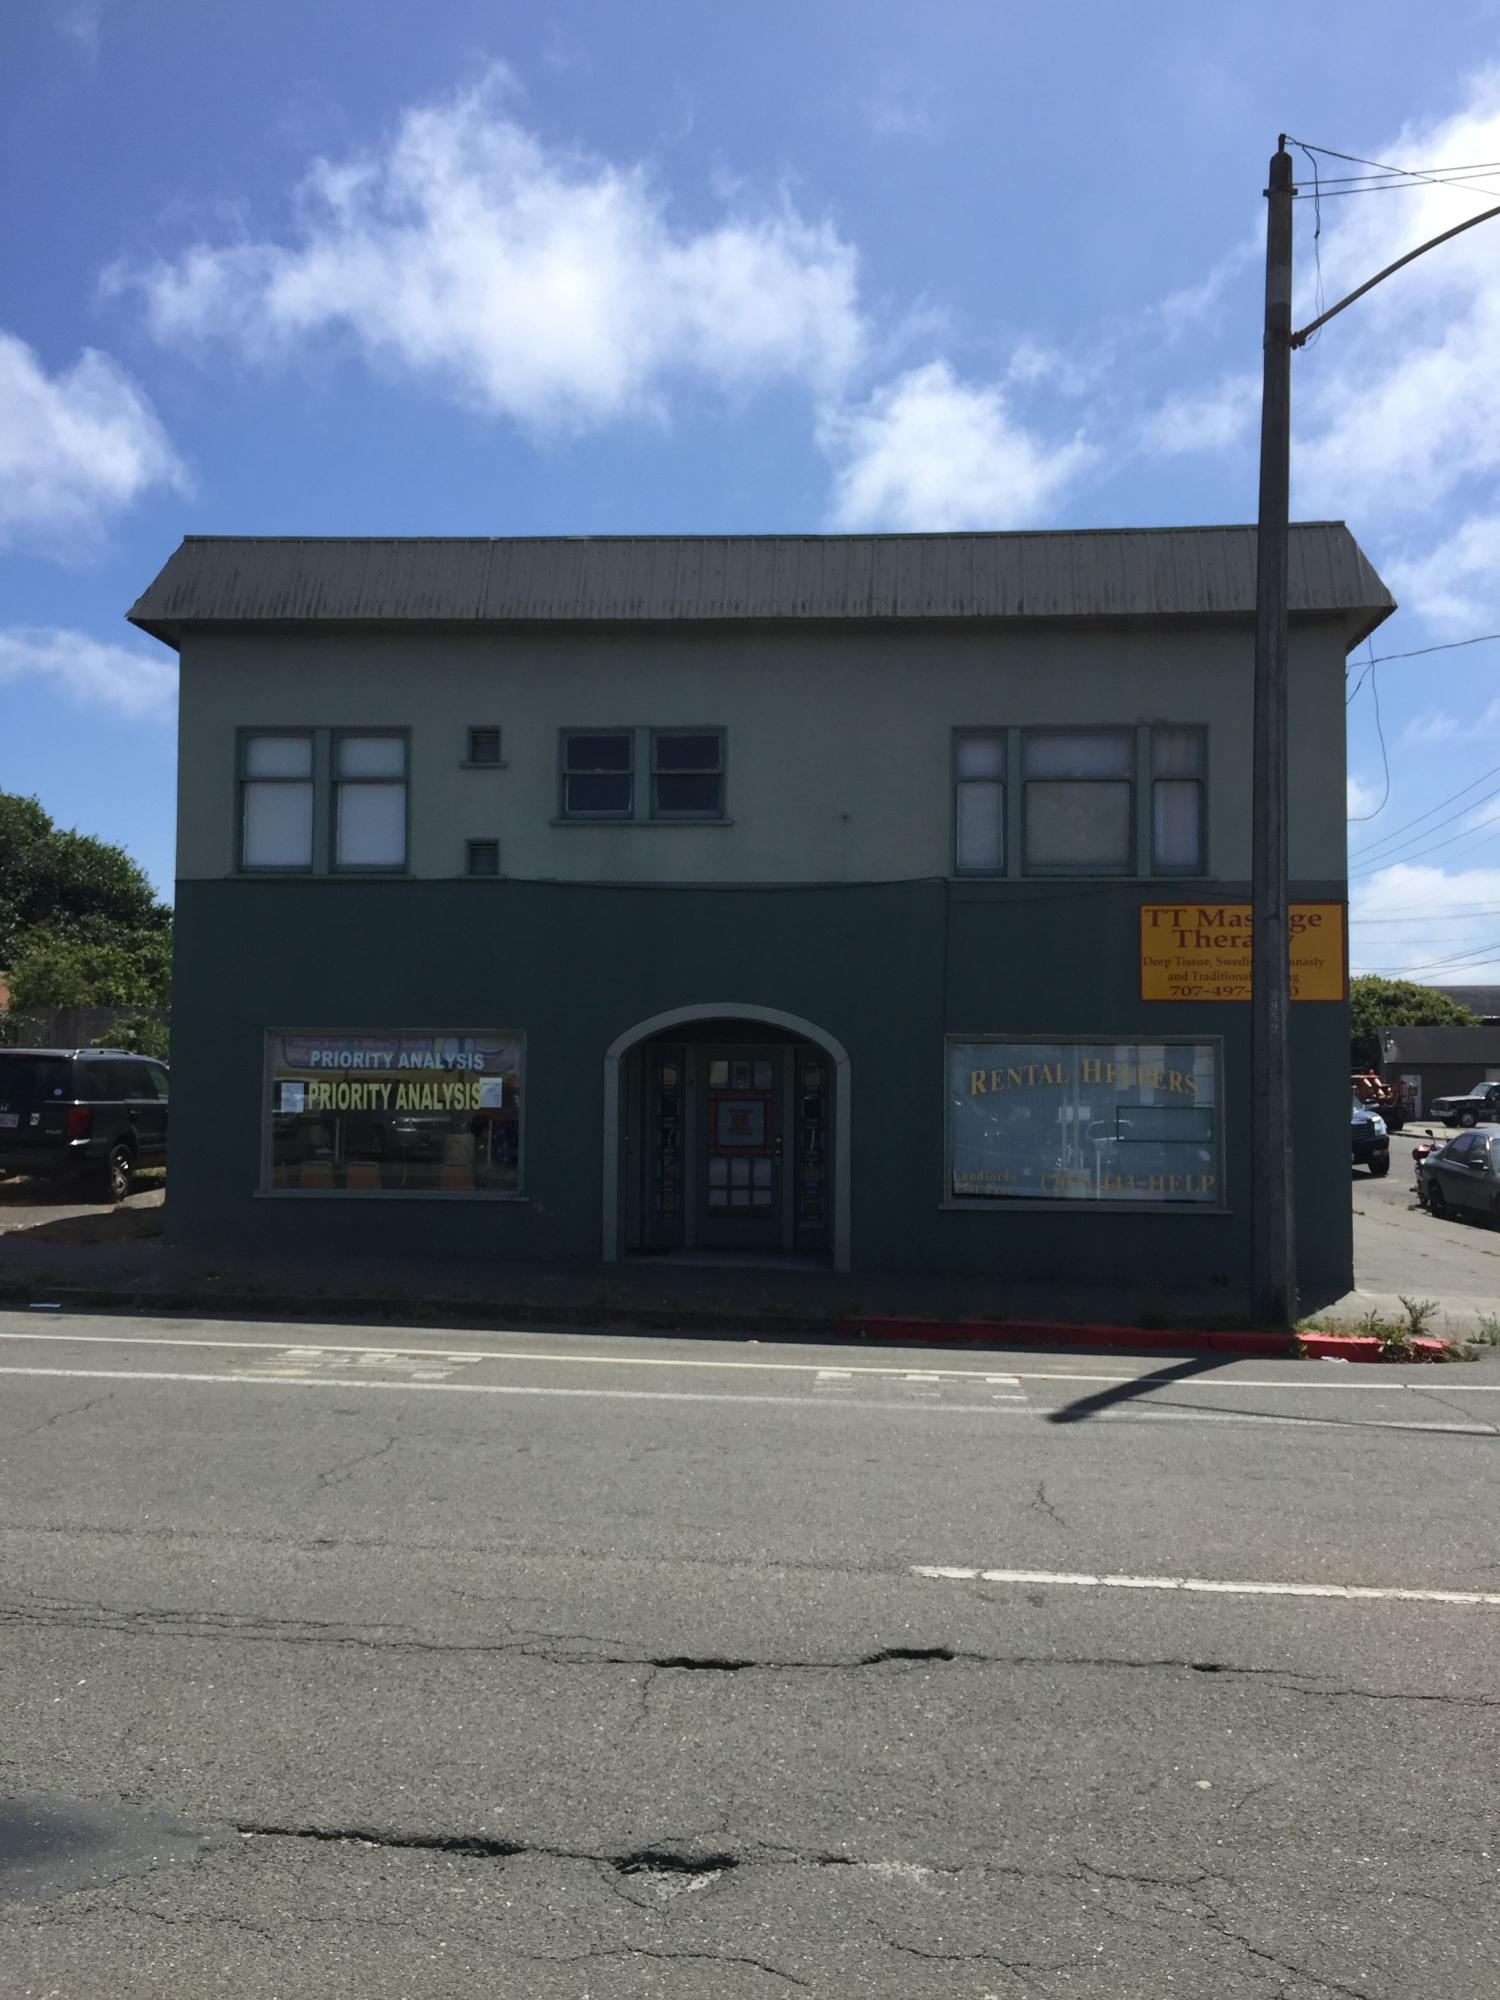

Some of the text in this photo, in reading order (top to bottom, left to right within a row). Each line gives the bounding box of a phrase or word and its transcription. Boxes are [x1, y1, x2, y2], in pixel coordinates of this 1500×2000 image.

[1145, 909, 1323, 934] TT Masge
[1172, 929, 1294, 949] Thera
[1143, 957, 1172, 968] Deep
[1174, 957, 1213, 967] Tissue,
[1215, 957, 1253, 967] Swedi
[1168, 971, 1188, 982] and
[1169, 985, 1299, 998] 707-497-0
[309, 1050, 485, 1071] PRIORITY ANALYSIS
[969, 1061, 1071, 1097] RENTAL
[308, 1081, 393, 1111] PRIORITY
[395, 1082, 482, 1111] ANALYSIS
